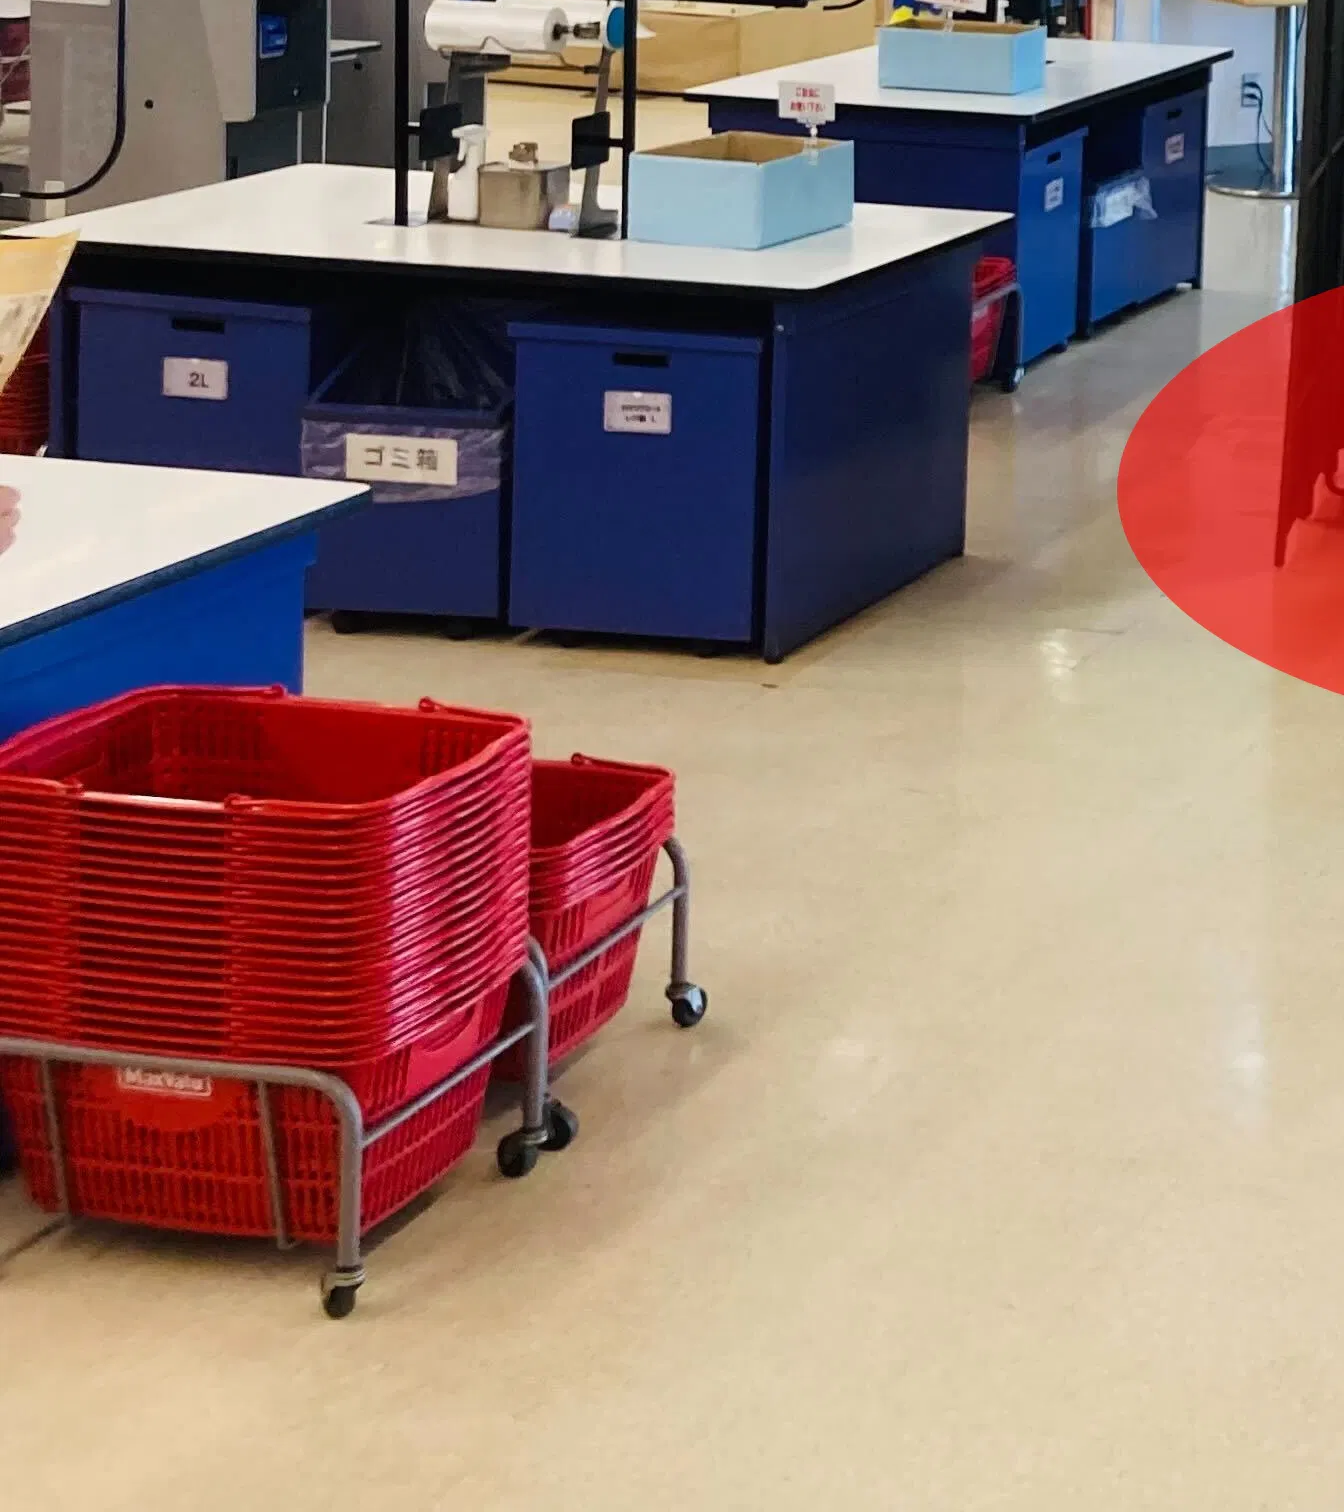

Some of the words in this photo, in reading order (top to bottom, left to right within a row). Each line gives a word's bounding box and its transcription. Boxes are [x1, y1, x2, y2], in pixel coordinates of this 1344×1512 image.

[188, 371, 209, 388] 2L
[364, 445, 428, 471] ゴミ箱
